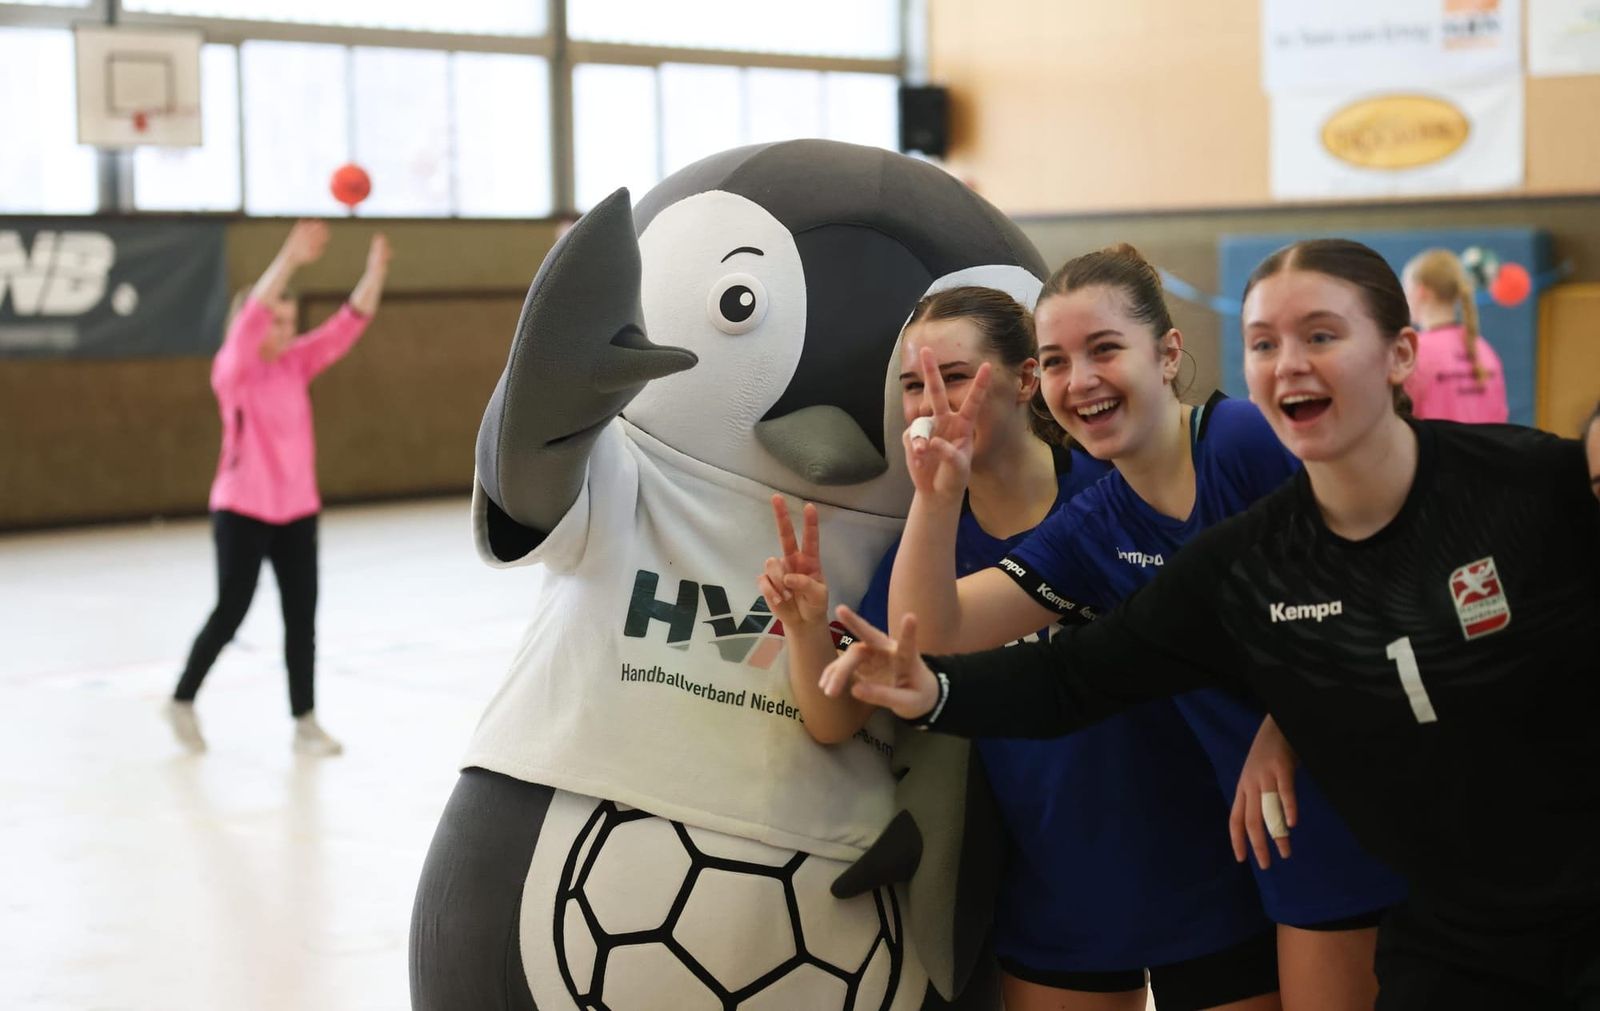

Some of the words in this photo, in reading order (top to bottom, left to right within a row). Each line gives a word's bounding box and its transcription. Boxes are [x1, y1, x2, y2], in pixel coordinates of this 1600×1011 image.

[1036, 582, 1076, 610] Kempa
[1269, 600, 1343, 623] Kempa
[620, 663, 747, 707] Handballverband
[1385, 636, 1438, 724] 1
